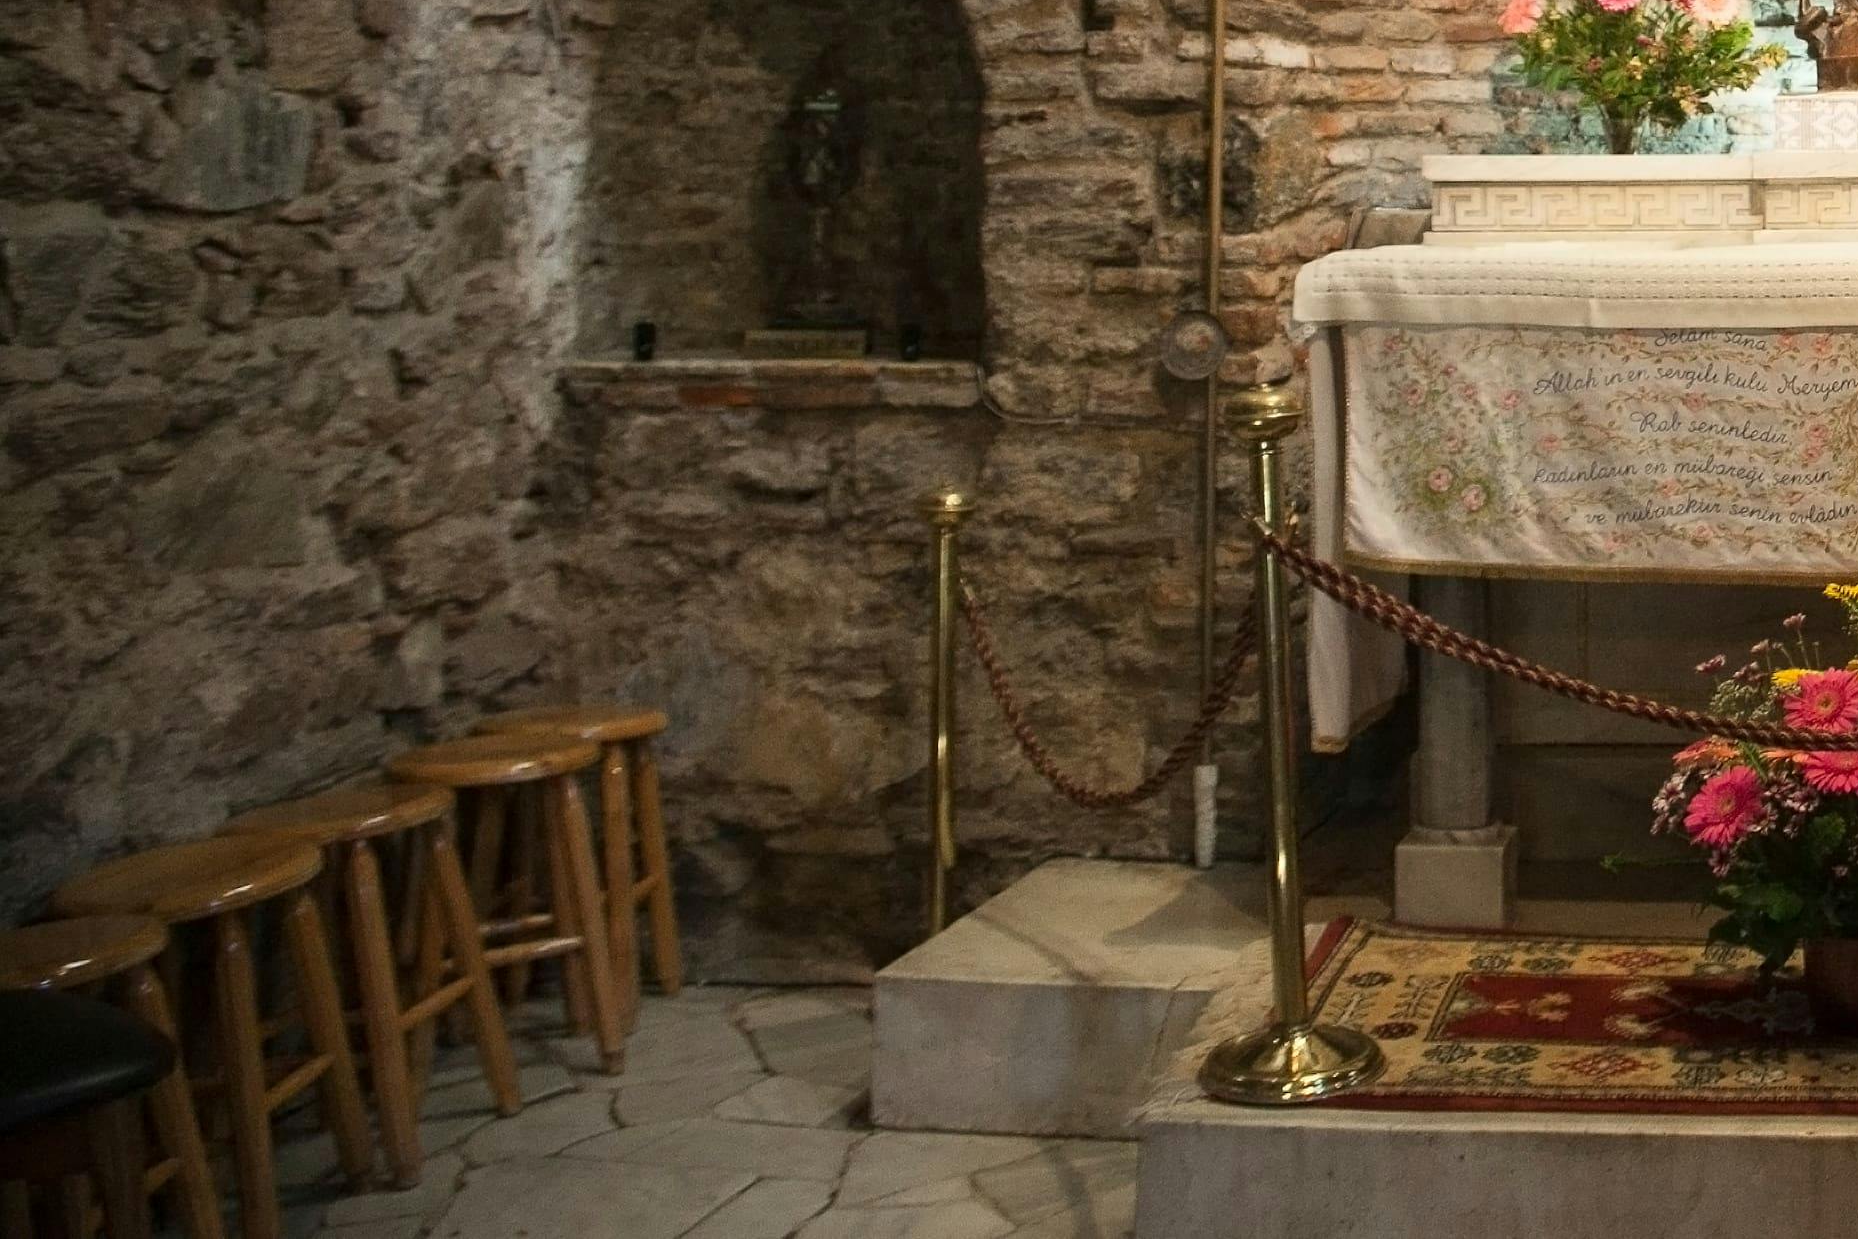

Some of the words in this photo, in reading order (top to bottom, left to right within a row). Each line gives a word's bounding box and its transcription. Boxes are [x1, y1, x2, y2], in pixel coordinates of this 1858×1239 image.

[1723, 365, 1768, 391] kulu
[1629, 410, 1683, 433] Rab
[1644, 462, 1668, 475] en
[1583, 512, 1607, 525] ve
[1728, 502, 1783, 525] senin
